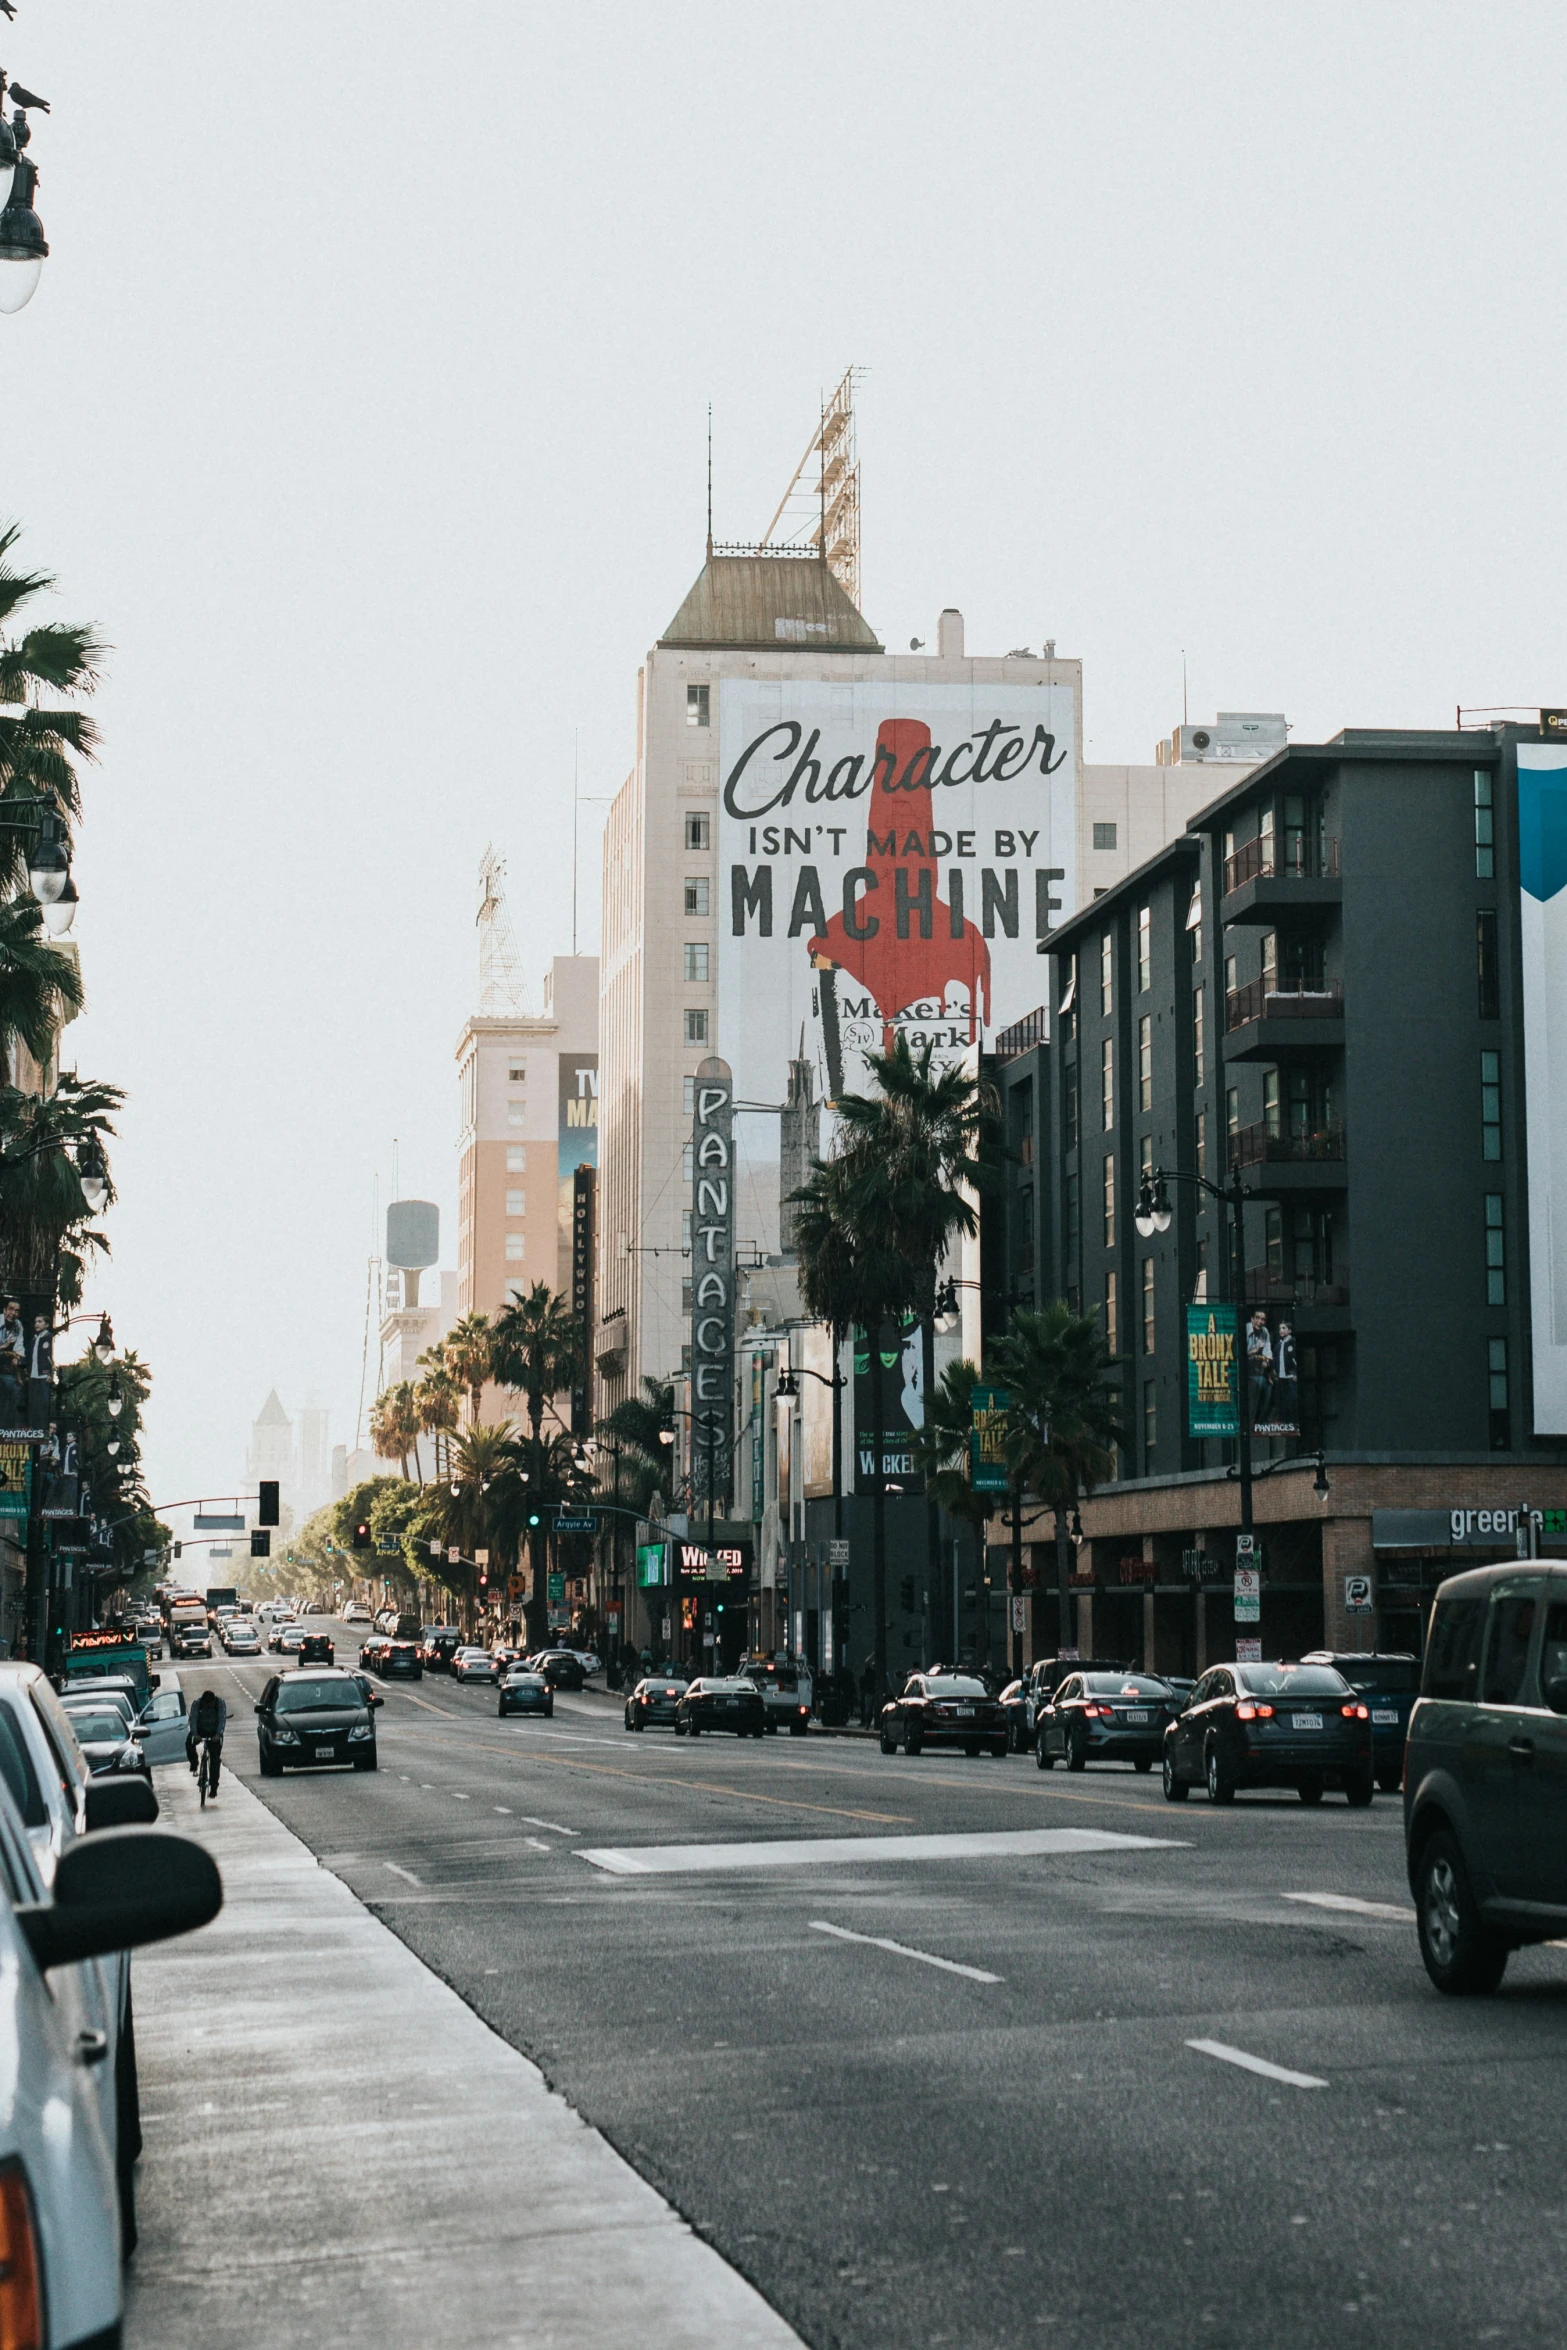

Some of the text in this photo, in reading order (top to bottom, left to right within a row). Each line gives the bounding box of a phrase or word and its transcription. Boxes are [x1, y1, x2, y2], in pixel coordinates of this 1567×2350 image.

[724, 719, 1067, 819] Character
[749, 825, 1040, 857] ISN'T MADE BY
[731, 865, 1065, 939] MACHINE
[696, 1088, 729, 1446] PANTAGES
[1208, 1313, 1216, 1333] A
[1189, 1333, 1234, 1360] BRONX
[1196, 1361, 1229, 1388] TALE
[988, 1392, 995, 1408] A
[0, 1429, 44, 1439] PANTAGES
[1254, 1423, 1295, 1432] PANTAGES
[859, 1451, 915, 1475] WCKE
[557, 1521, 581, 1529] Argyle
[1451, 1503, 1543, 1540] greene
[681, 1546, 742, 1567] WICED
